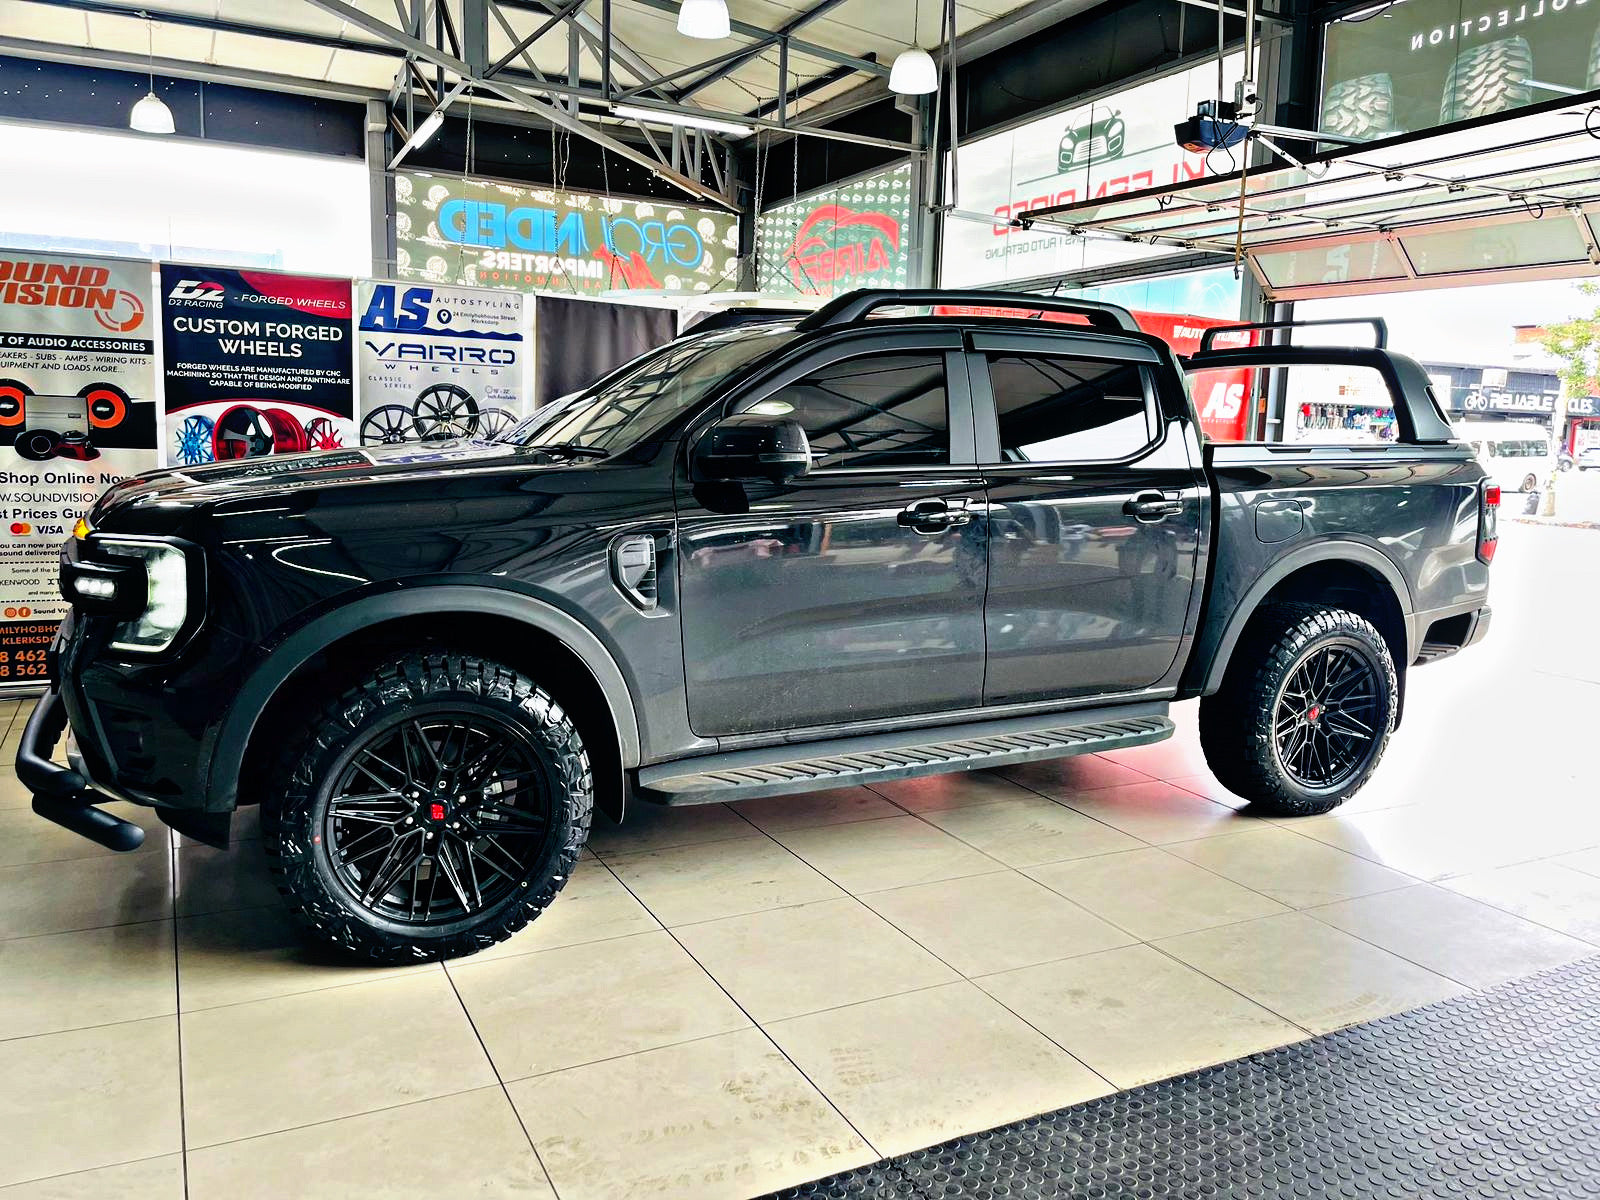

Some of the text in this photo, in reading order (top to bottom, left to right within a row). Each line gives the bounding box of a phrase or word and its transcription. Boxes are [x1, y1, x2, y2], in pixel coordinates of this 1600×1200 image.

[0, 282, 116, 310] ISION
[241, 294, 346, 310] FORGED WHEELS
[435, 296, 520, 310] AUTOSTYLING
[168, 298, 224, 309] D2 RACING
[359, 284, 434, 331] AS
[173, 316, 343, 342] CUSTOM FORGED
[8, 336, 24, 345] OF
[27, 337, 68, 348] AUDIO
[70, 339, 146, 352] ACCESSORIES
[218, 338, 303, 358] WHEELS
[35, 353, 57, 361] SUBS
[65, 354, 88, 362] AMPS
[95, 356, 128, 364] WIRING
[129, 357, 147, 365] KITS
[176, 362, 208, 370] FORGED
[208, 364, 240, 372] WHEELS
[256, 367, 315, 376] MANUFACTURED
[385, 363, 499, 375] WHEELS
[166, 370, 211, 379] MACHINING
[259, 374, 286, 382] DESIGN
[286, 375, 302, 383] AND
[303, 376, 336, 384] PAINTING
[368, 375, 403, 383] CLASSIC
[209, 380, 243, 388] CAPABLE
[278, 383, 313, 391] MODIFIED
[1201, 382, 1245, 419] AS
[1489, 392, 1553, 411] RELIABLE
[0, 472, 39, 486] Shop
[44, 472, 95, 484] Online
[12, 508, 58, 519] Prices
[62, 508, 87, 519] Gu
[36, 525, 64, 535] VISA
[15, 649, 47, 662] 462
[16, 663, 47, 676] 562
